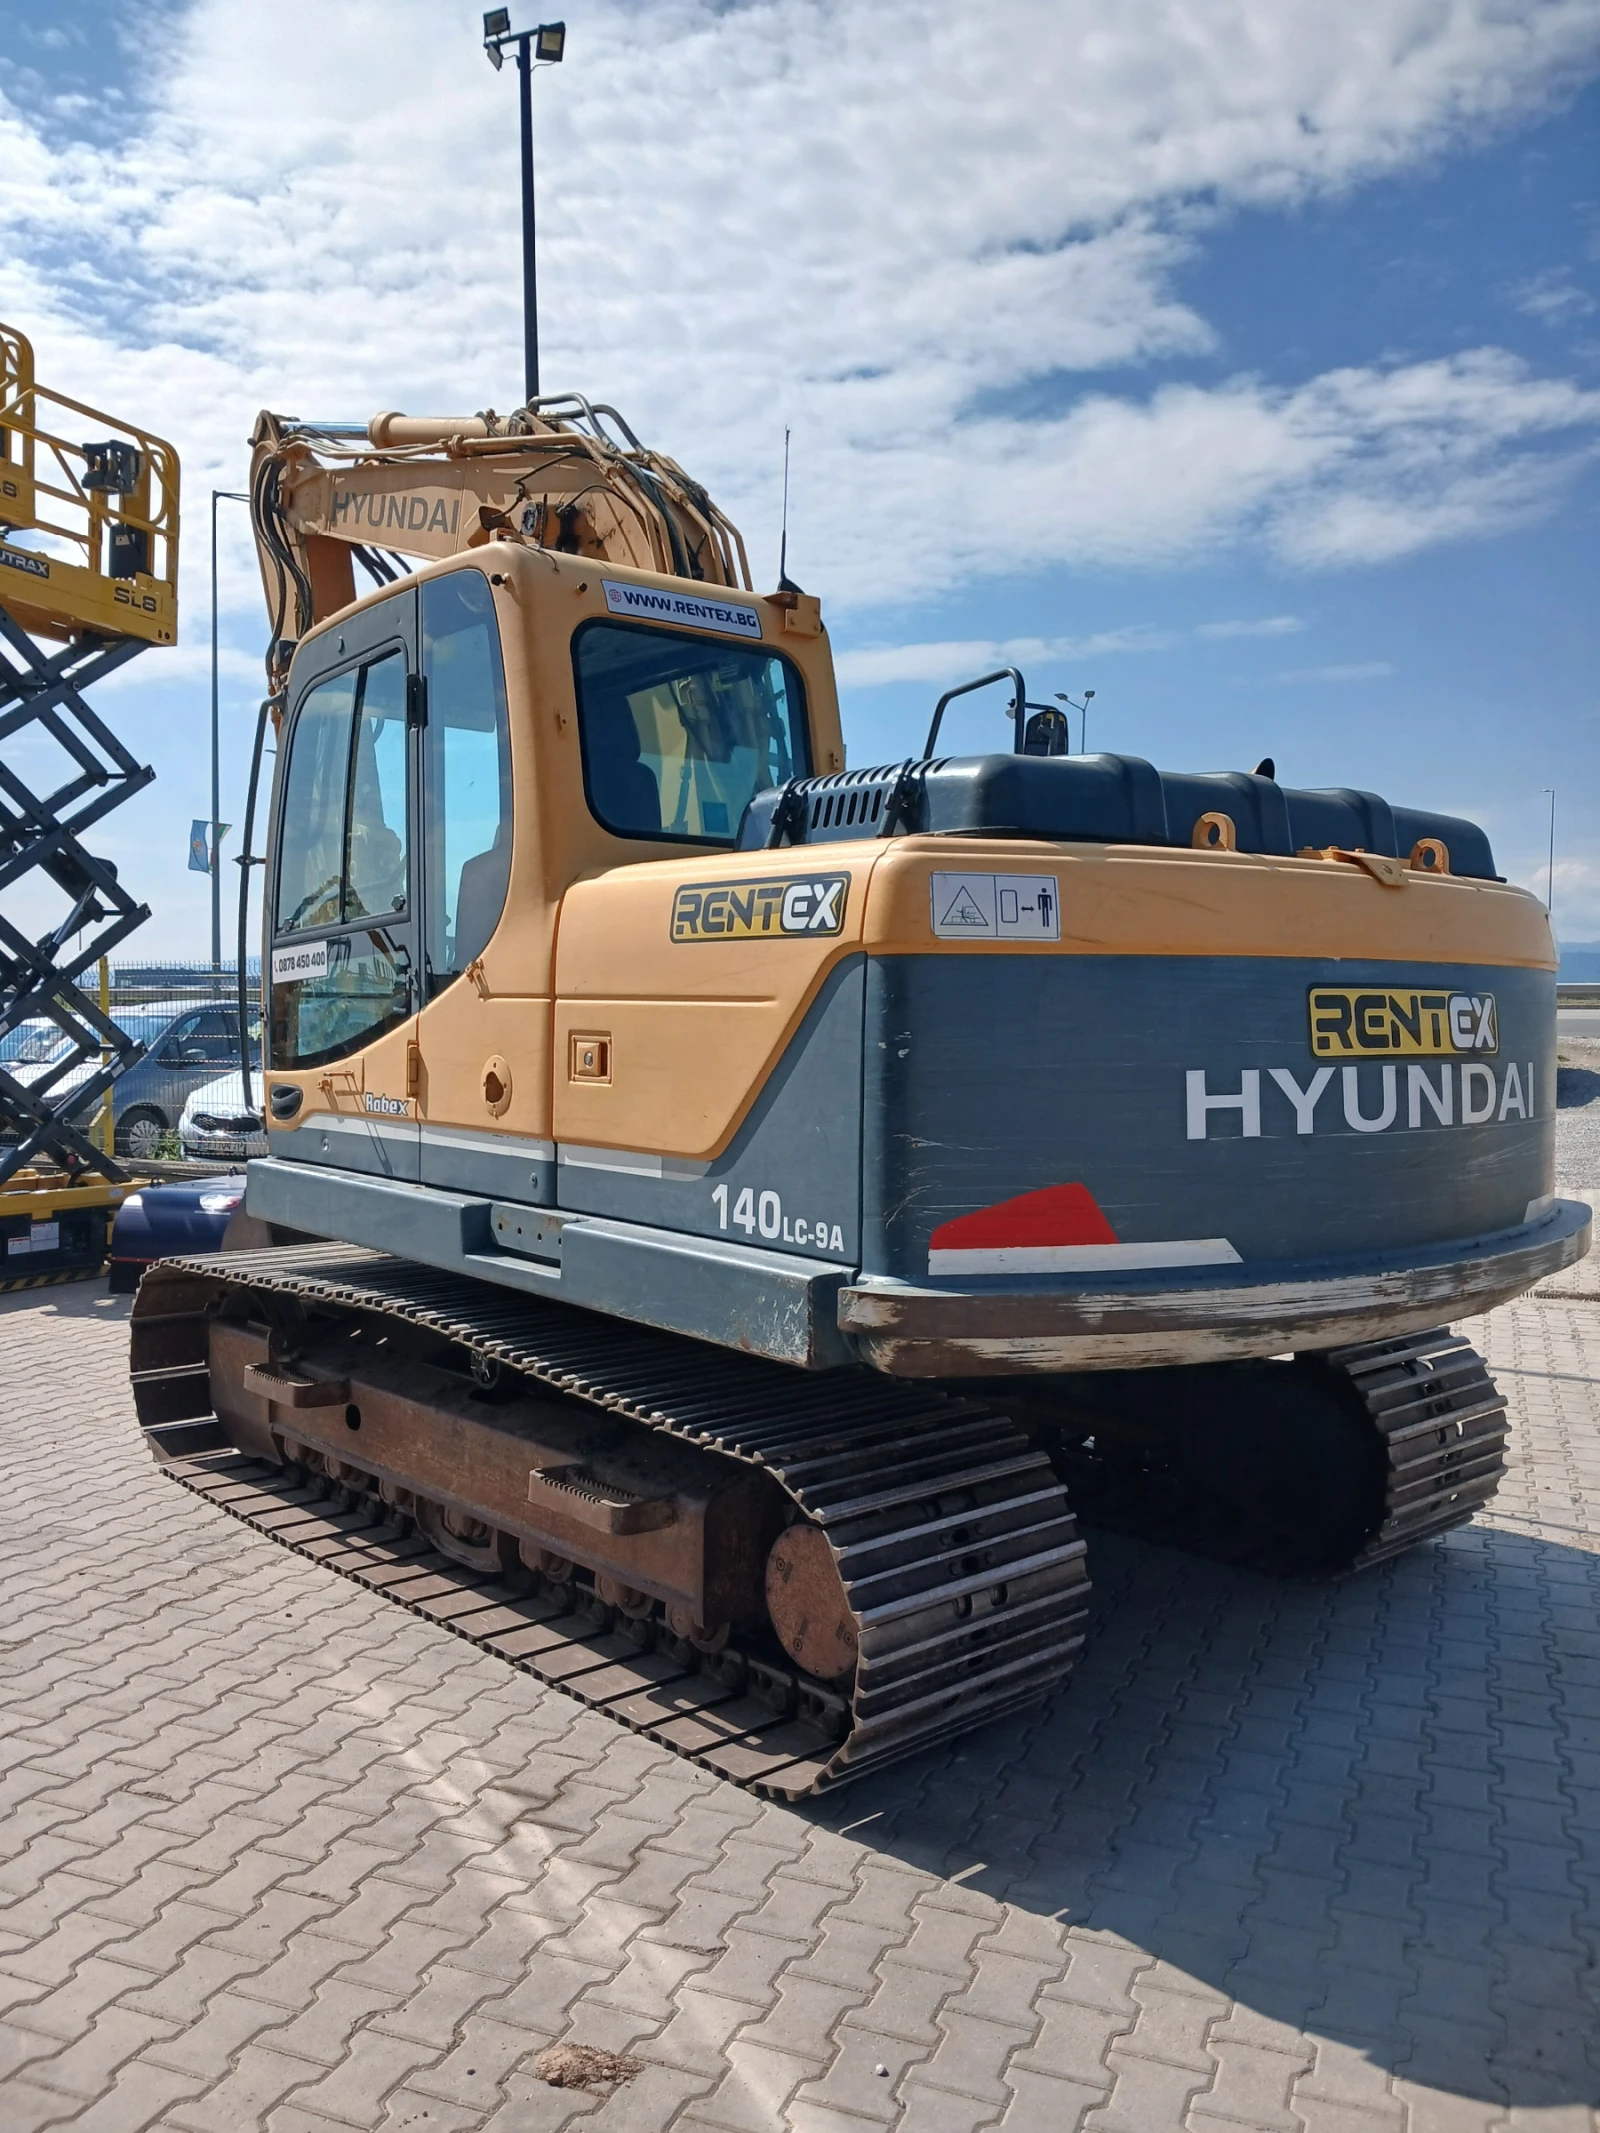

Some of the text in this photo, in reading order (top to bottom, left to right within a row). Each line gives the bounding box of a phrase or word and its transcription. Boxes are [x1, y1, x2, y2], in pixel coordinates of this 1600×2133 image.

[331, 491, 460, 534] HYUNDAI
[114, 586, 157, 612] SL8
[622, 590, 757, 628] WWW.RENTEX.BG
[675, 881, 843, 936] RENTEX
[278, 950, 326, 973] 0878 450 400
[1313, 993, 1497, 1051] RENTEX
[365, 1091, 410, 1117] Robex
[1186, 1061, 1534, 1141] HYUNDAI
